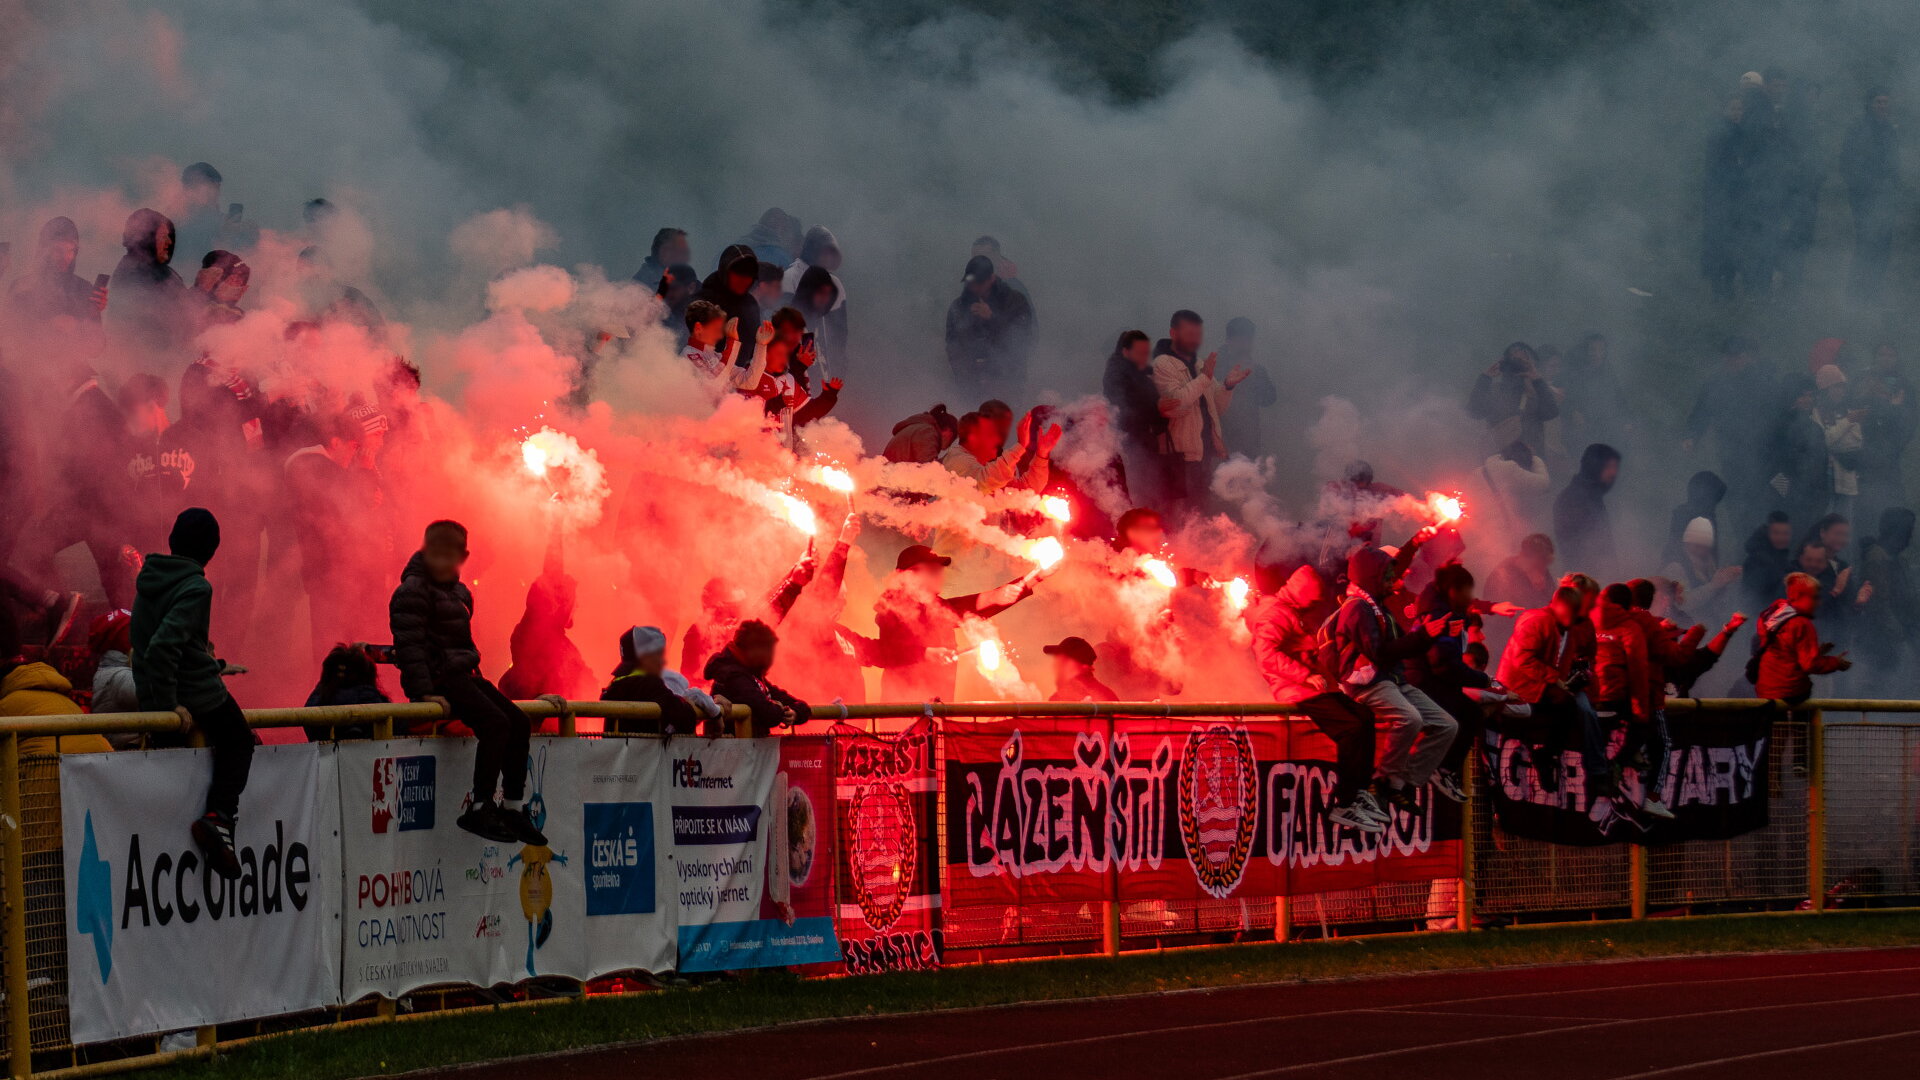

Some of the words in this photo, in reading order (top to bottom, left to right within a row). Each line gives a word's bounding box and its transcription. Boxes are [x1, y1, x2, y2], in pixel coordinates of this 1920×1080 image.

[402, 806, 416, 824] SVAZ
[674, 815, 705, 835] PŘIPOJTE
[706, 818, 716, 834] SE
[716, 818, 723, 834] K
[724, 815, 752, 834] NÁM
[592, 832, 624, 868] ČESKÁ
[679, 884, 714, 912] optický
[358, 911, 446, 947] GRAOTNOST
